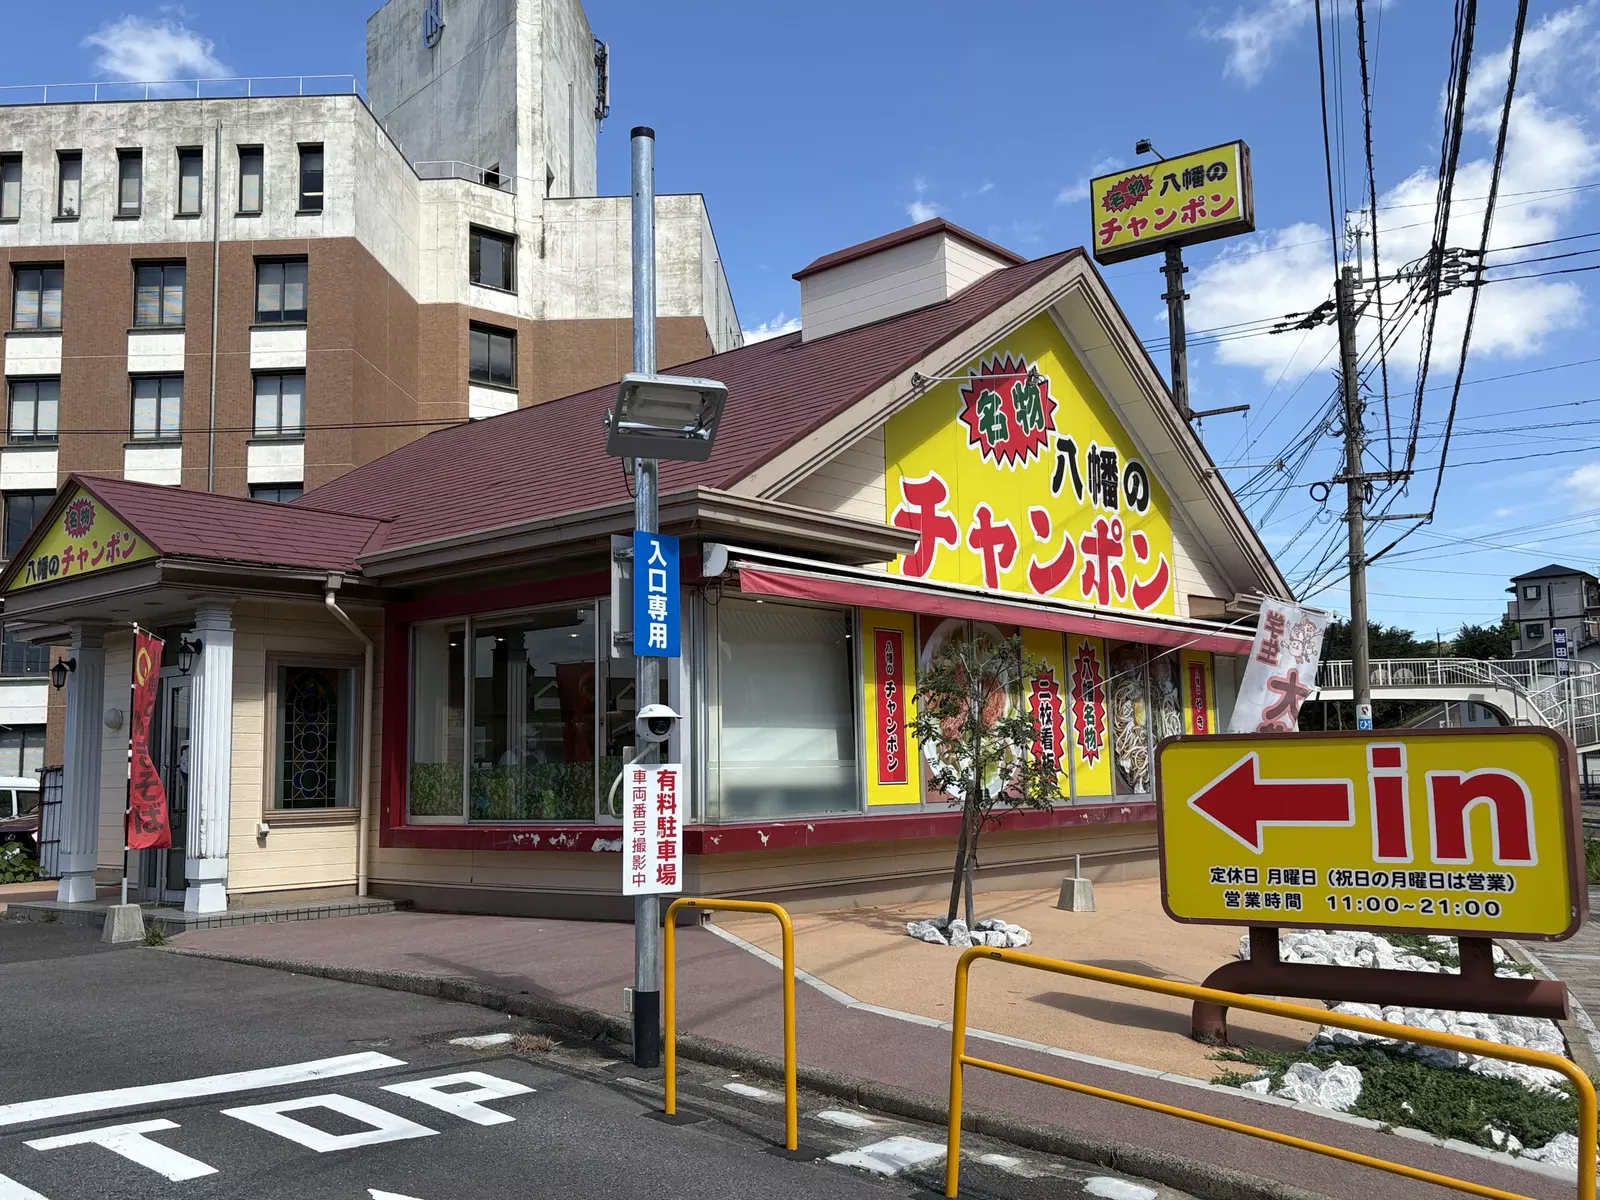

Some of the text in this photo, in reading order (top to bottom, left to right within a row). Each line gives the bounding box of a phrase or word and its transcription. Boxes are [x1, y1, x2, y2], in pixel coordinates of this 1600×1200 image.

[1109, 179, 1146, 208] 名物
[1159, 161, 1228, 197] 八幡の
[1098, 193, 1235, 246] チャンポン
[976, 381, 1046, 448] 名物
[1051, 435, 1150, 513] 八幡の
[69, 506, 90, 530] 名物
[894, 471, 1170, 612] チャンポン
[647, 540, 667, 649] 入口専用
[885, 640, 894, 675] 八幡の
[1082, 657, 1097, 750] 八幡名物
[1257, 668, 1311, 732] 大
[632, 770, 647, 888] 車両番号撮影中
[656, 769, 677, 886] 有料駐車場
[1368, 742, 1536, 865] in
[1210, 867, 1258, 885] 定休日
[1267, 868, 1316, 886] 月曜日
[1224, 891, 1301, 910] 営業時間
[0, 1071, 538, 1200] TOP
